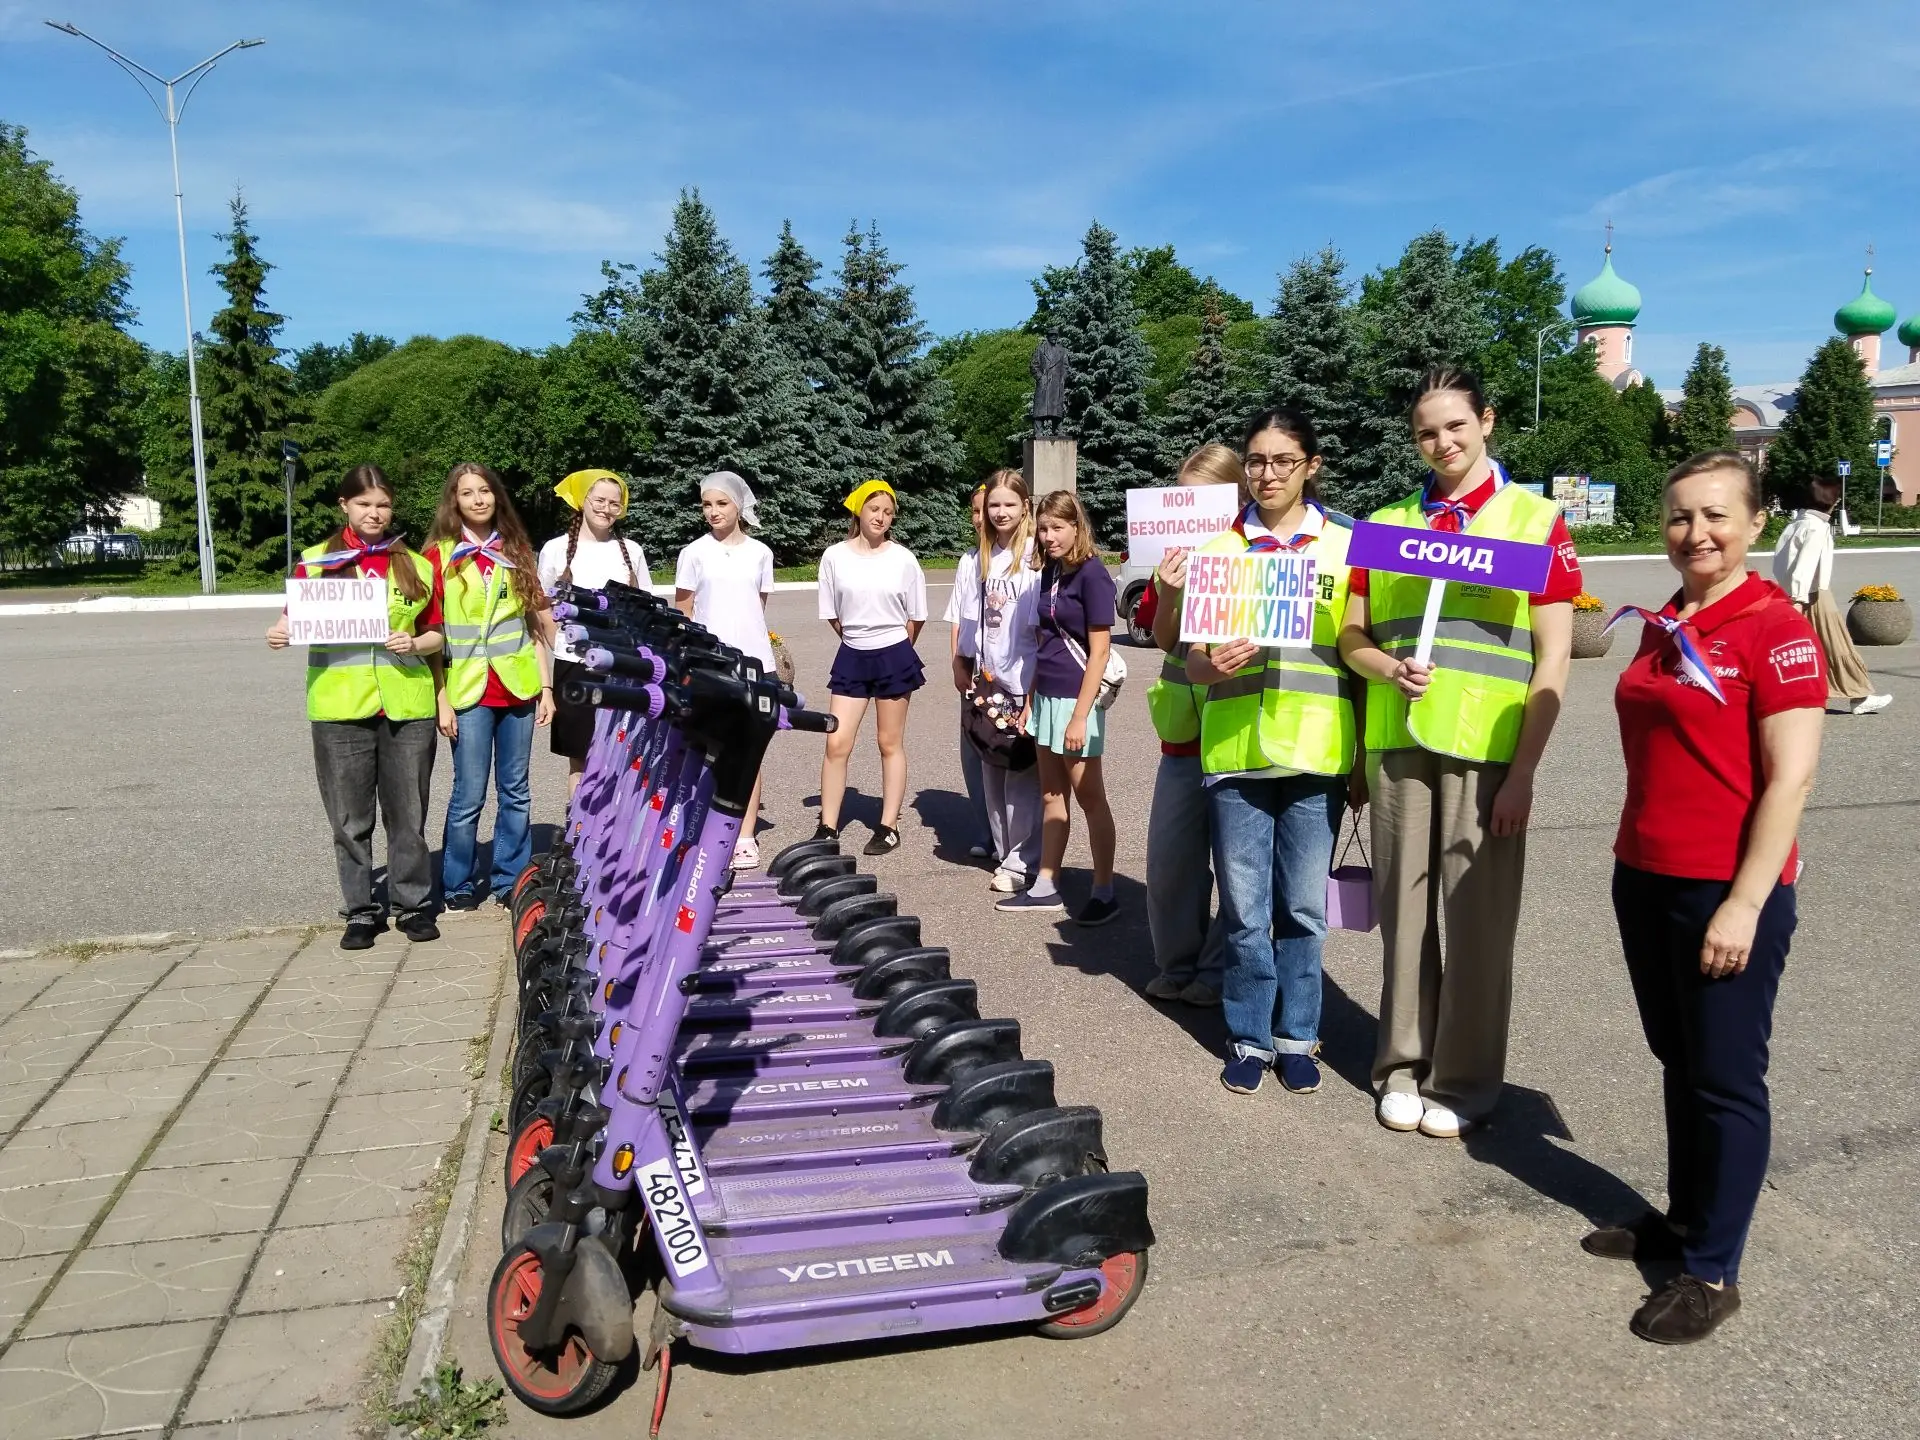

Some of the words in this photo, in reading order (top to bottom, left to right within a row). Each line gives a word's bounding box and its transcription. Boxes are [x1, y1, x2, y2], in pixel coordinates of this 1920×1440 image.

[1163, 488, 1195, 507] МОЙ
[1129, 514, 1231, 536] БЕЗОПАСНЫЙ
[1399, 538, 1494, 574] СЮИД
[299, 581, 346, 602] ЖИВУ
[351, 581, 374, 601] ПО
[1189, 555, 1316, 598] #БЕЗОПАСНЫЕ
[292, 618, 387, 640] ПРАВИЛАМ!
[1184, 596, 1313, 640] КАНИКУЛЫ
[669, 784, 686, 825] ЮРЕНТ
[687, 800, 703, 841] ЮРЕНТ
[685, 847, 708, 903] ЮРЕНТ
[733, 1077, 869, 1096] УСПЕЕМ
[738, 1133, 787, 1144] ХОЧУ
[646, 1173, 702, 1265] 482100
[777, 1249, 955, 1283] УСПЕЕМ
